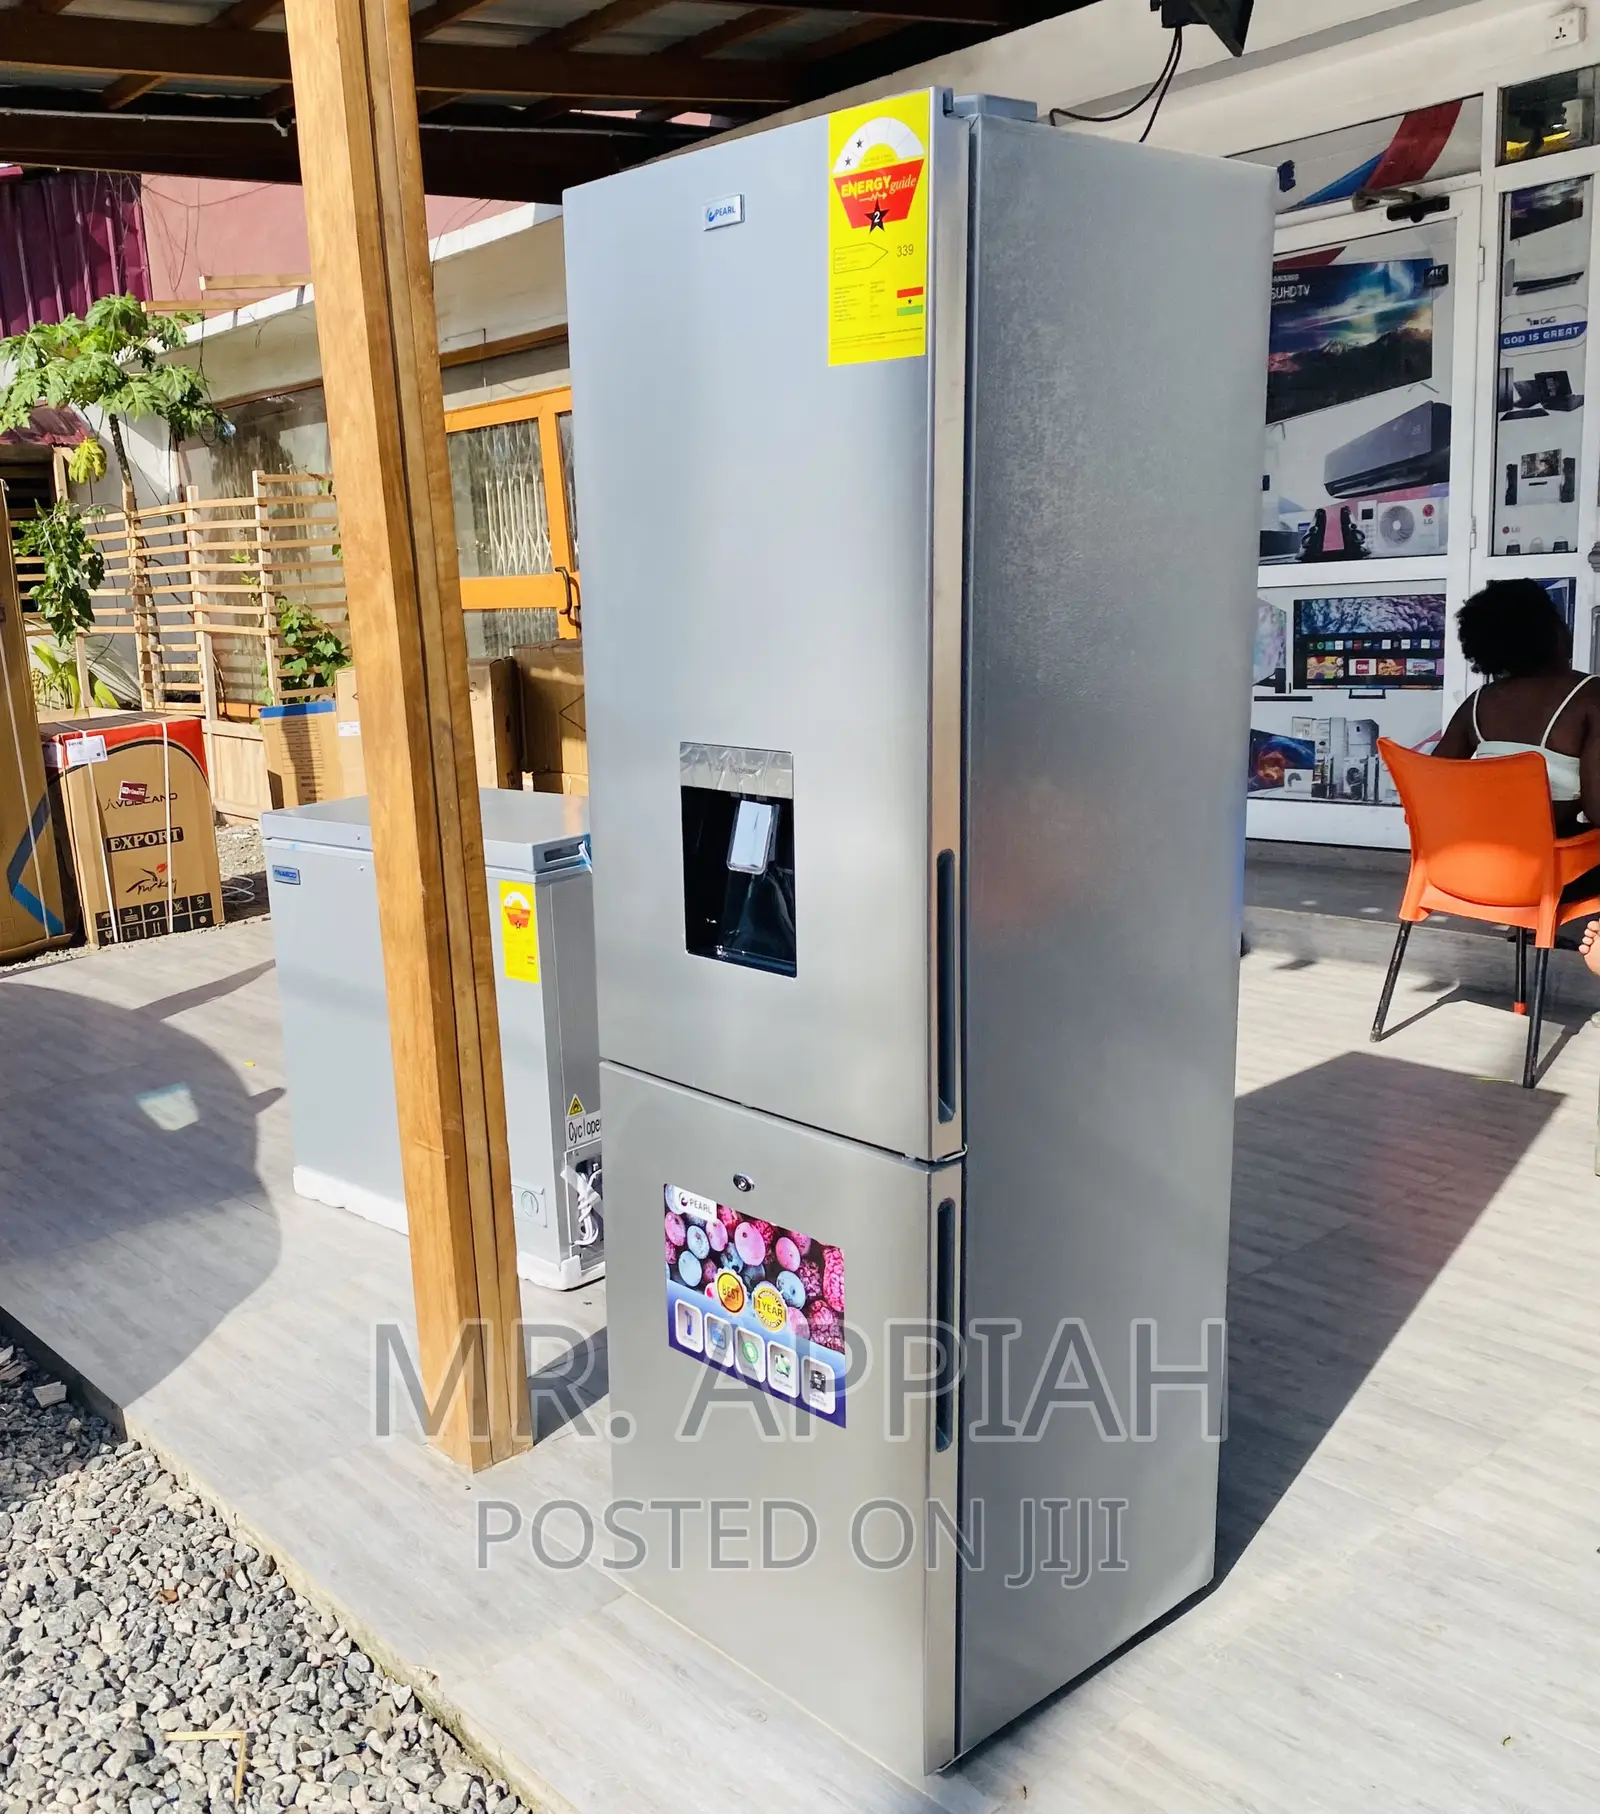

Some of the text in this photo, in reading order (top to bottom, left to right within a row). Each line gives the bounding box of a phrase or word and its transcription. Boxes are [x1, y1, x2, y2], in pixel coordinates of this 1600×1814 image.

[841, 174, 917, 199] ENERGY guide
[714, 205, 736, 217] PEARL
[873, 211, 881, 223] 2
[896, 243, 914, 257] 339
[1503, 326, 1580, 345] GOD IS GREAT
[110, 829, 181, 851] EXPORT
[688, 1198, 713, 1216] PEARL
[722, 1283, 740, 1302] BEST
